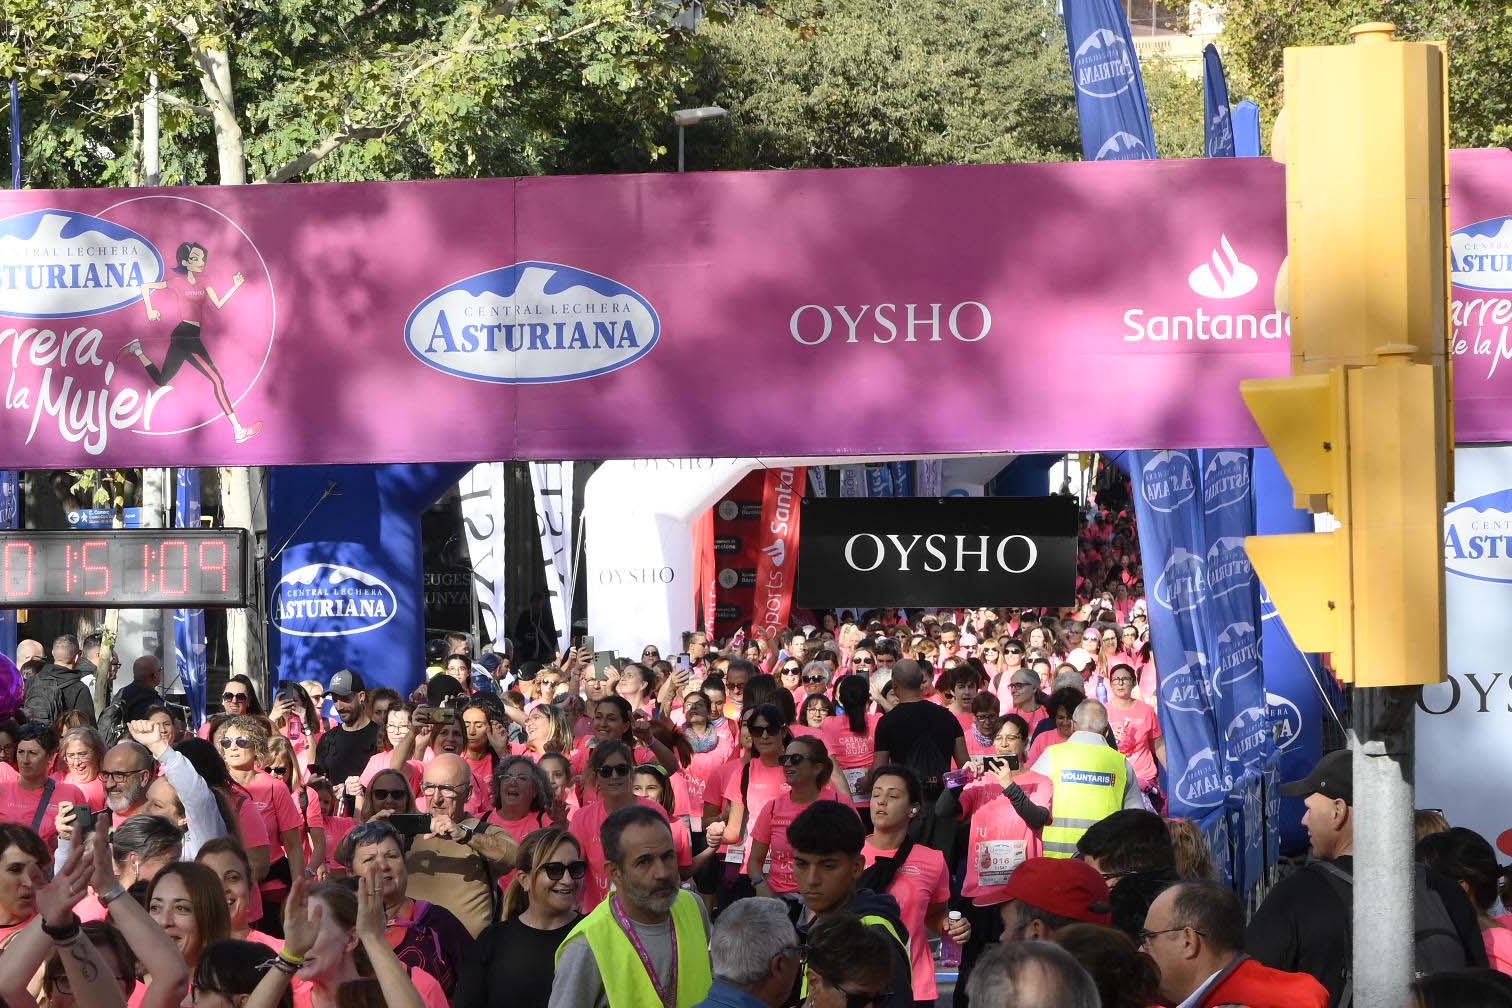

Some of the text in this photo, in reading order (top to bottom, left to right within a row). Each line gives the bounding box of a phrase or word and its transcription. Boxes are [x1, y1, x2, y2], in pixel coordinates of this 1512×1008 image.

[66, 244, 140, 257] LECHERA
[464, 302, 632, 316] CENTRAL LECHERA
[425, 308, 640, 354] ASTURIANA
[789, 301, 992, 346] OYSHO
[1473, 327, 1492, 355] la
[4, 371, 30, 411] la
[25, 361, 175, 456] Mujer
[844, 533, 1039, 574] OYSHO
[275, 592, 388, 621] ASTURIANA
[287, 588, 383, 598] CENTRAL LECHERA
[1063, 771, 1111, 784] VOLUNTARIS
